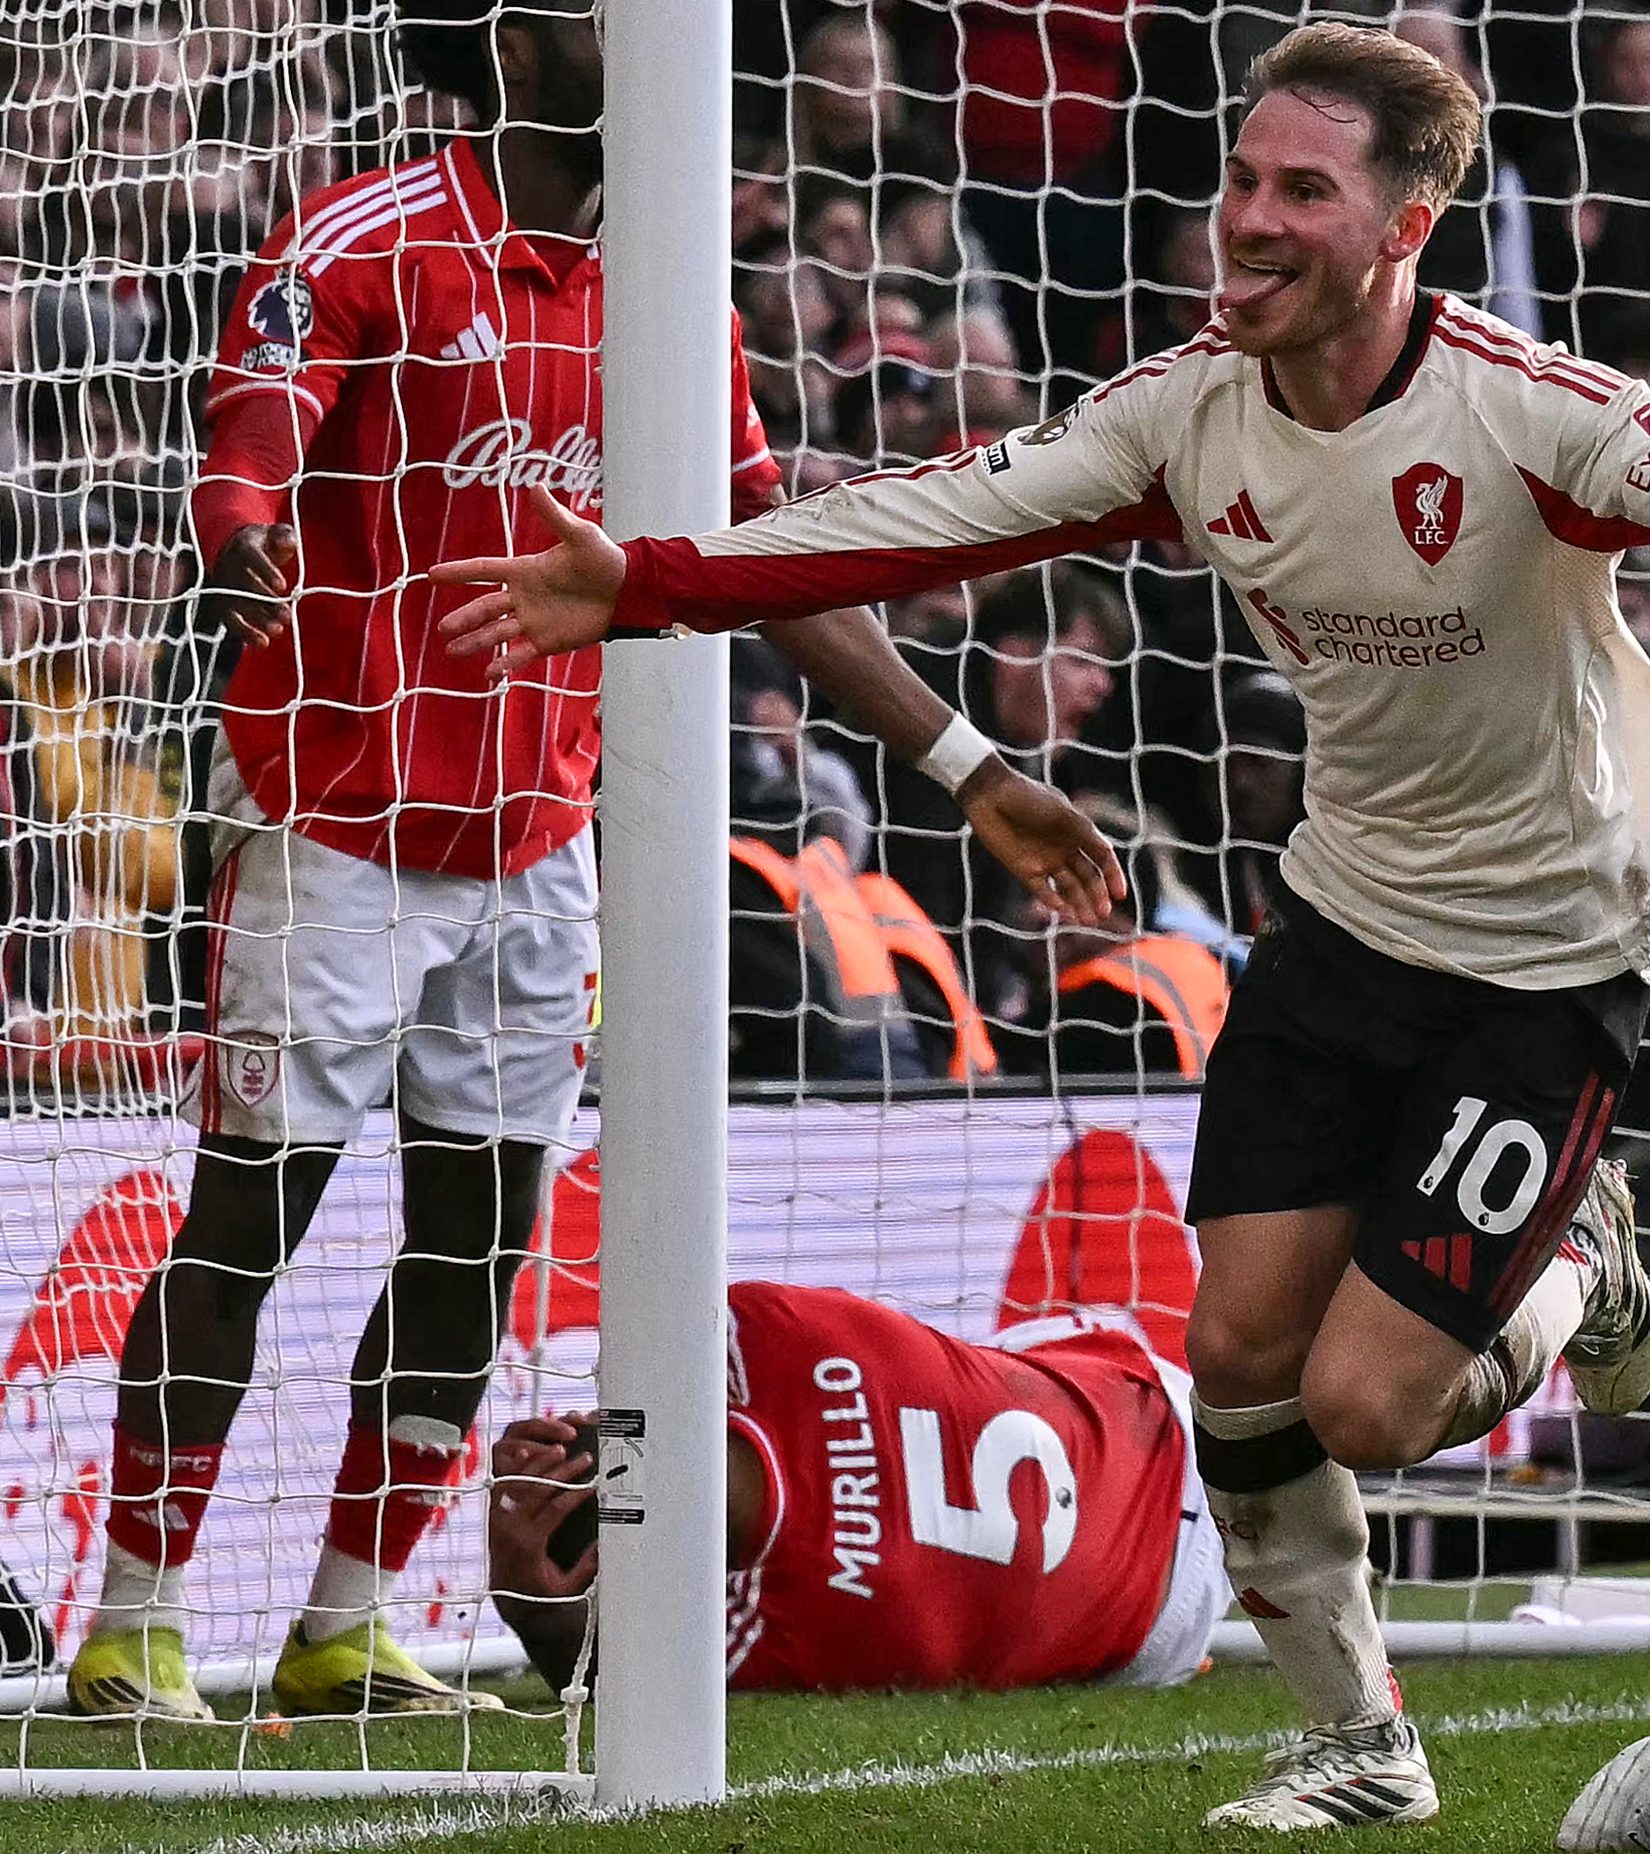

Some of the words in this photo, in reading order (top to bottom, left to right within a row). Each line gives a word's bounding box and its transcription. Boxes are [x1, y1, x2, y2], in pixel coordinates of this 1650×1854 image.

[1302, 605, 1467, 639] standard
[1314, 627, 1486, 668] chartered
[1416, 1096, 1548, 1235] 10
[813, 1356, 883, 1600] MURILLO
[899, 1406, 1078, 1575] 5
